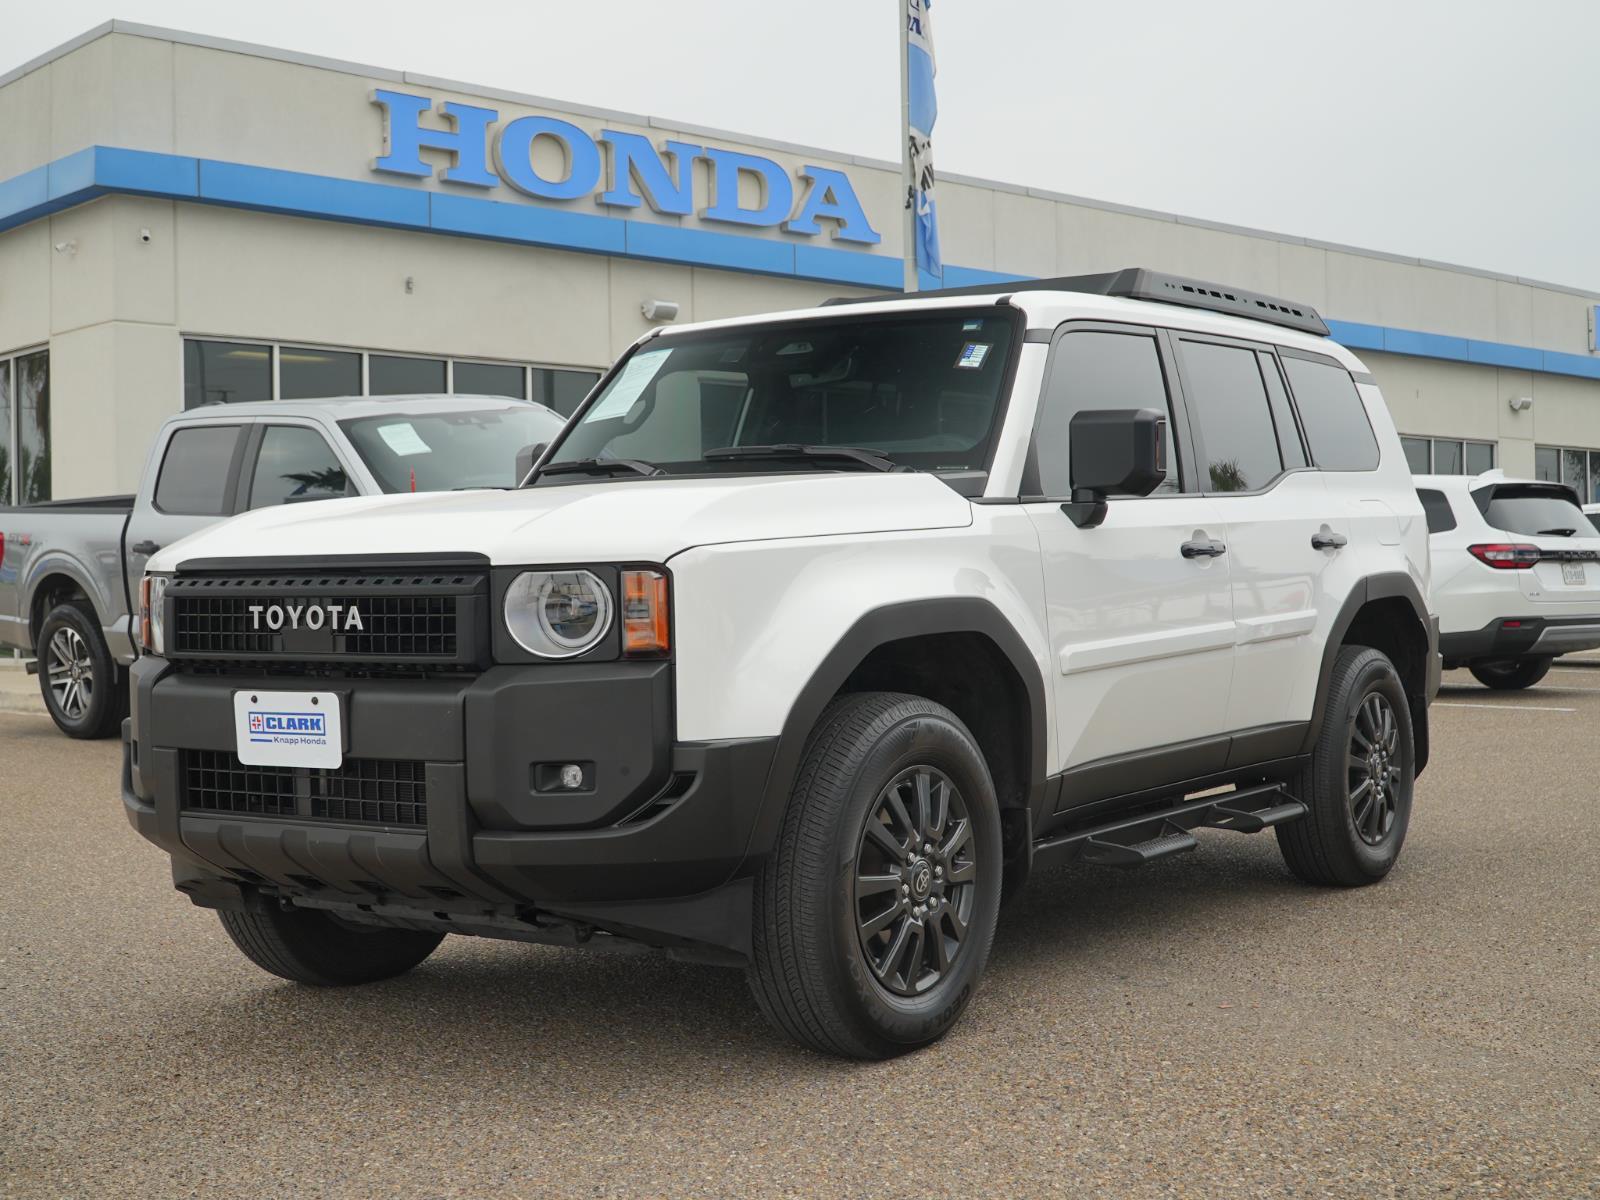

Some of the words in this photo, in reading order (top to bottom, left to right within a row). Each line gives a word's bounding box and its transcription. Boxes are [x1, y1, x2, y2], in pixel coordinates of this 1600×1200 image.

[369, 88, 881, 244] HONDA
[248, 604, 364, 631] TOYOTA
[266, 717, 322, 731] CLARK
[273, 736, 299, 745] Knapp
[300, 736, 327, 745] Honda
